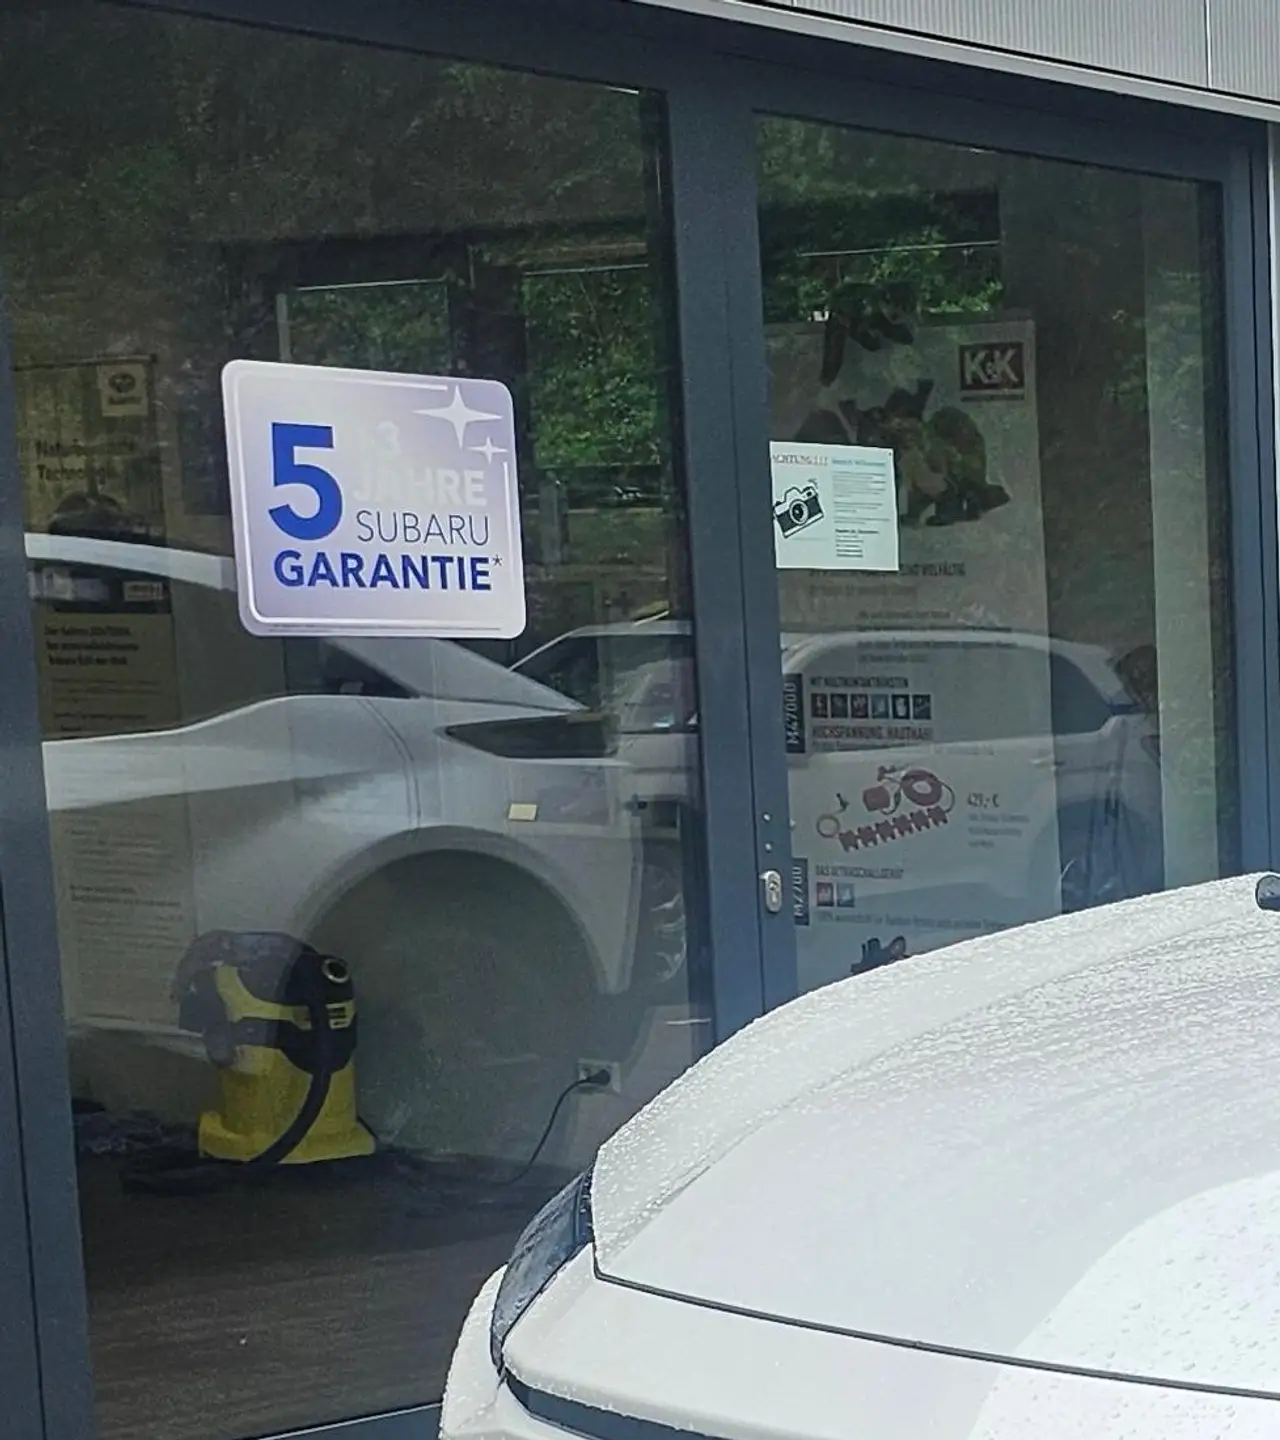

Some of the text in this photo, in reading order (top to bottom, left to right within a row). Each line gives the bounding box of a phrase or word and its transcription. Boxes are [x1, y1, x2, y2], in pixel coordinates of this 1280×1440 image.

[268, 421, 488, 542] 5 JAHRE
[355, 510, 490, 547] SUBARU
